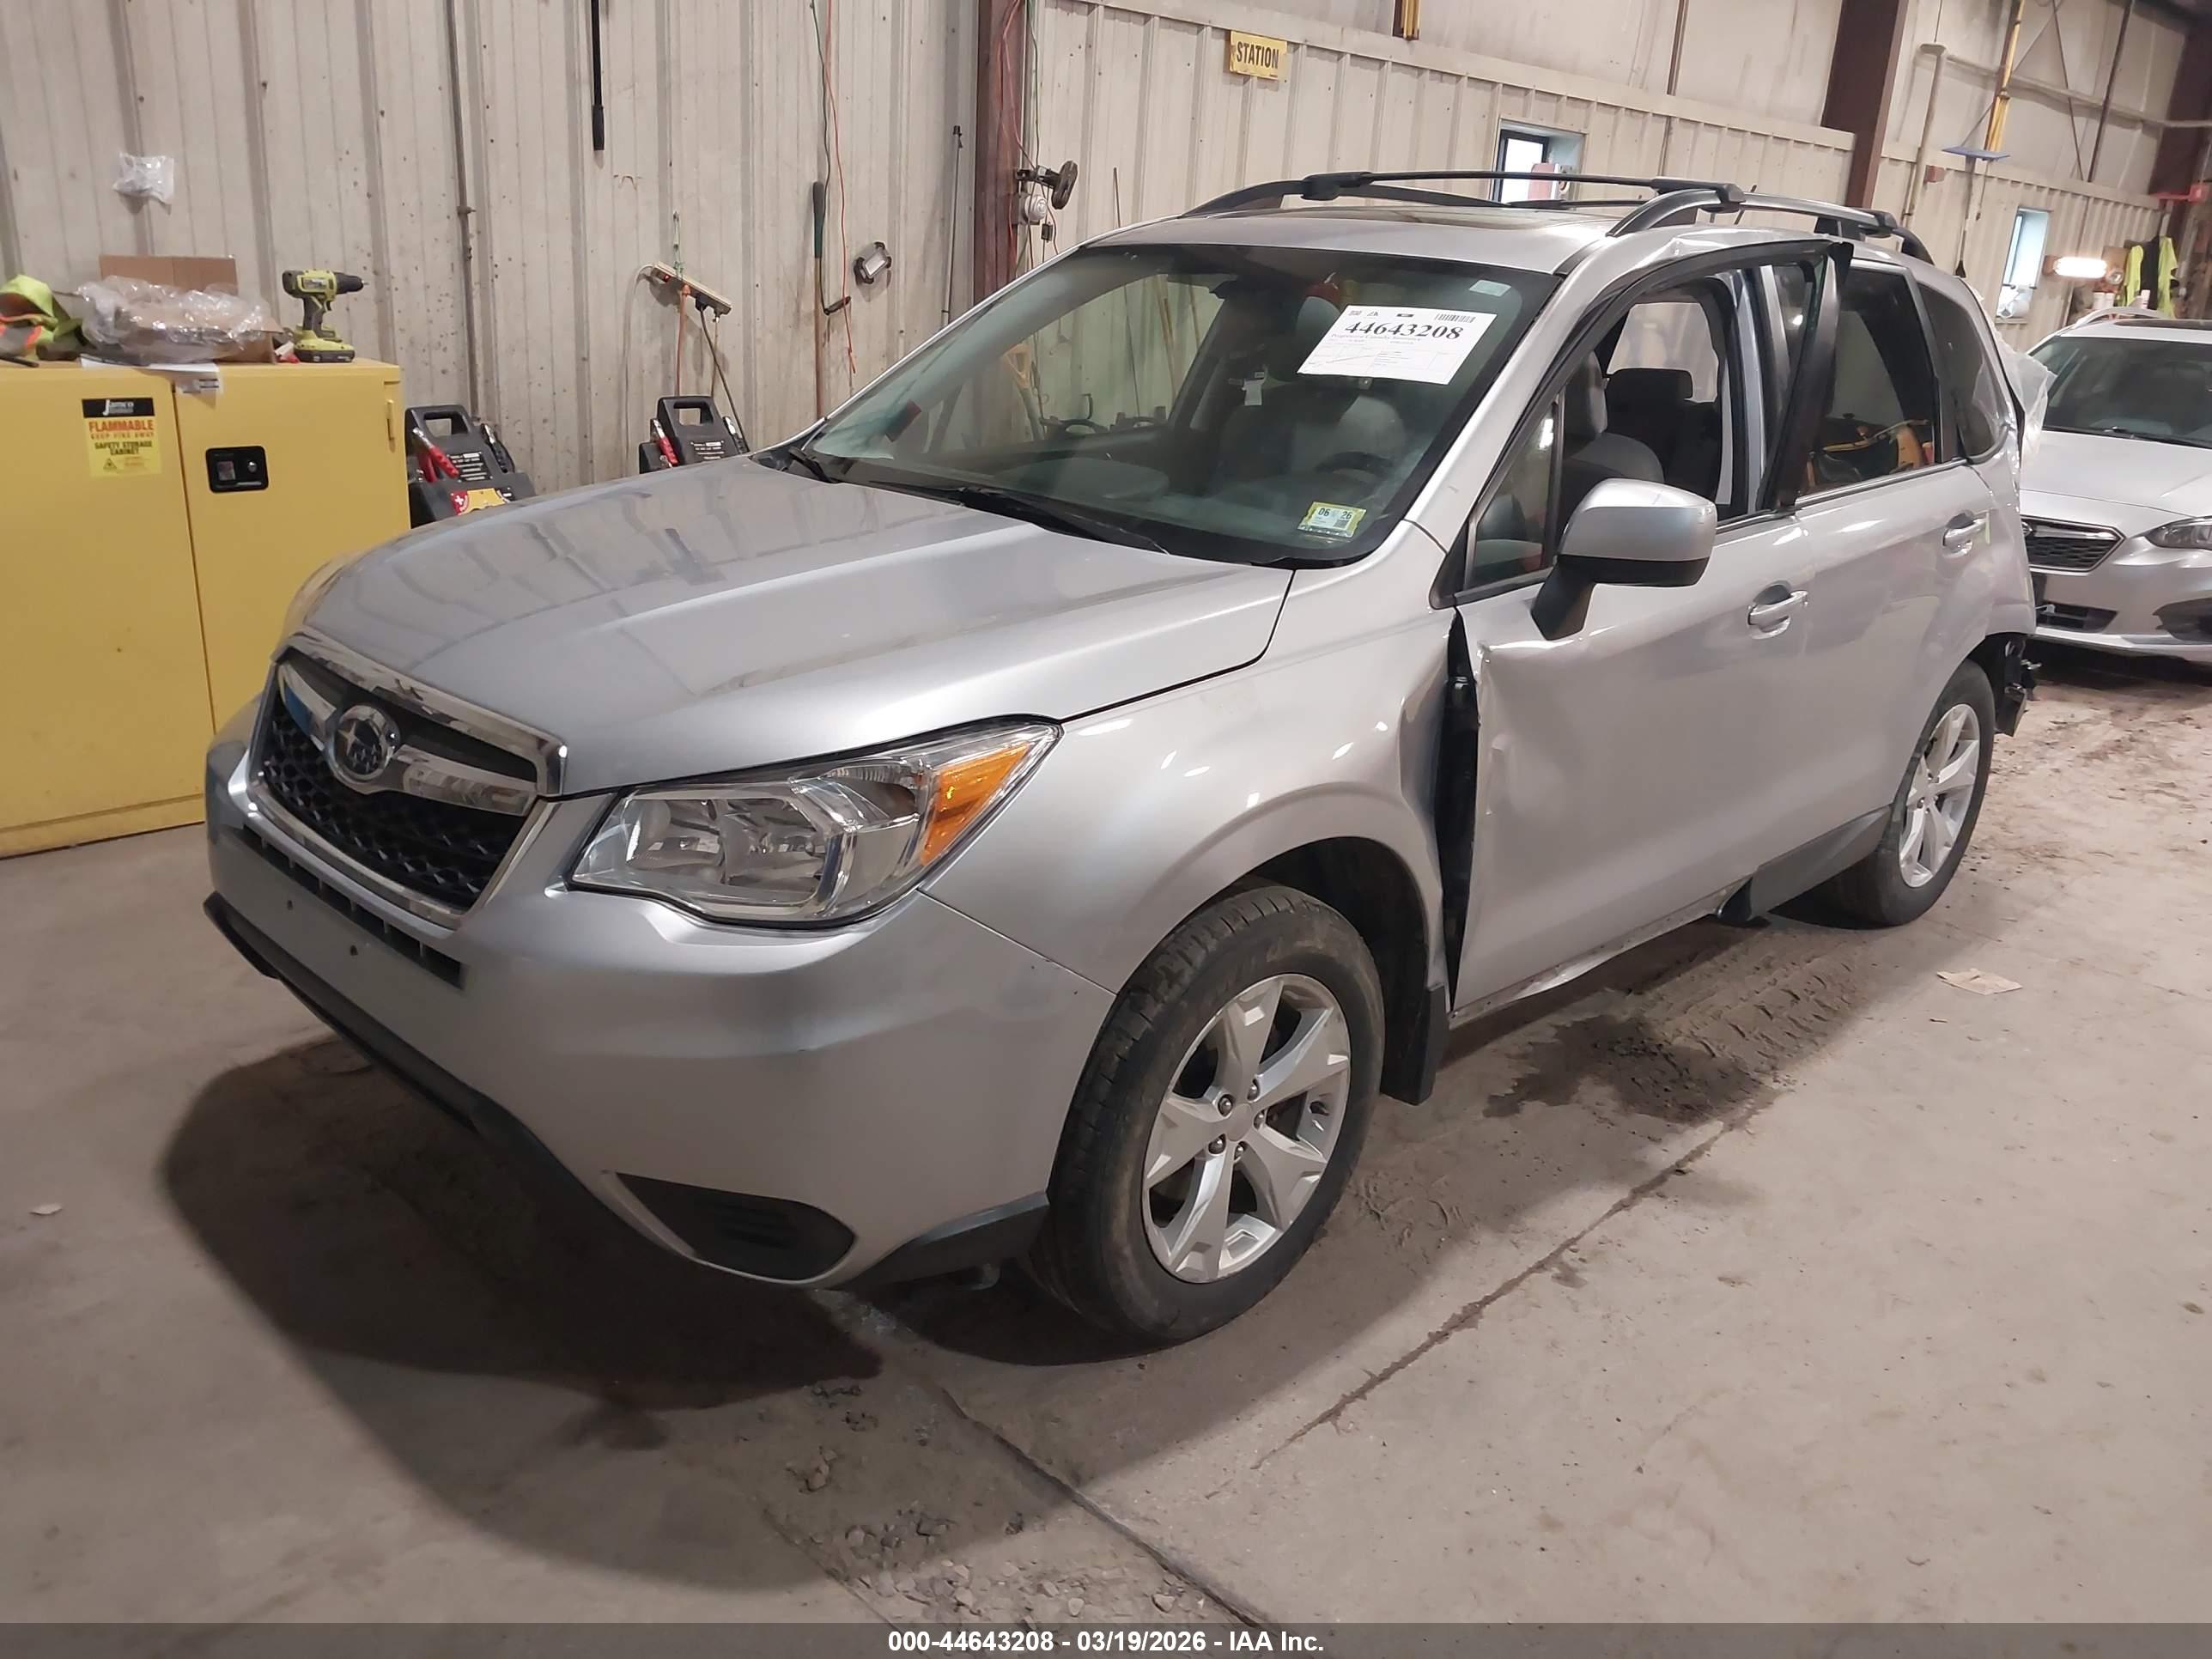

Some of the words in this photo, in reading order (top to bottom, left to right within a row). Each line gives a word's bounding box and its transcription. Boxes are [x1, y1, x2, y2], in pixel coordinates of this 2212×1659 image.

[1237, 41, 1279, 69] STATION
[1345, 321, 1464, 340] 44643208
[88, 420, 154, 432] FLAMMABLE
[110, 447, 139, 455] CABINET
[1318, 507, 1330, 517] 06
[1340, 511, 1352, 520] 26
